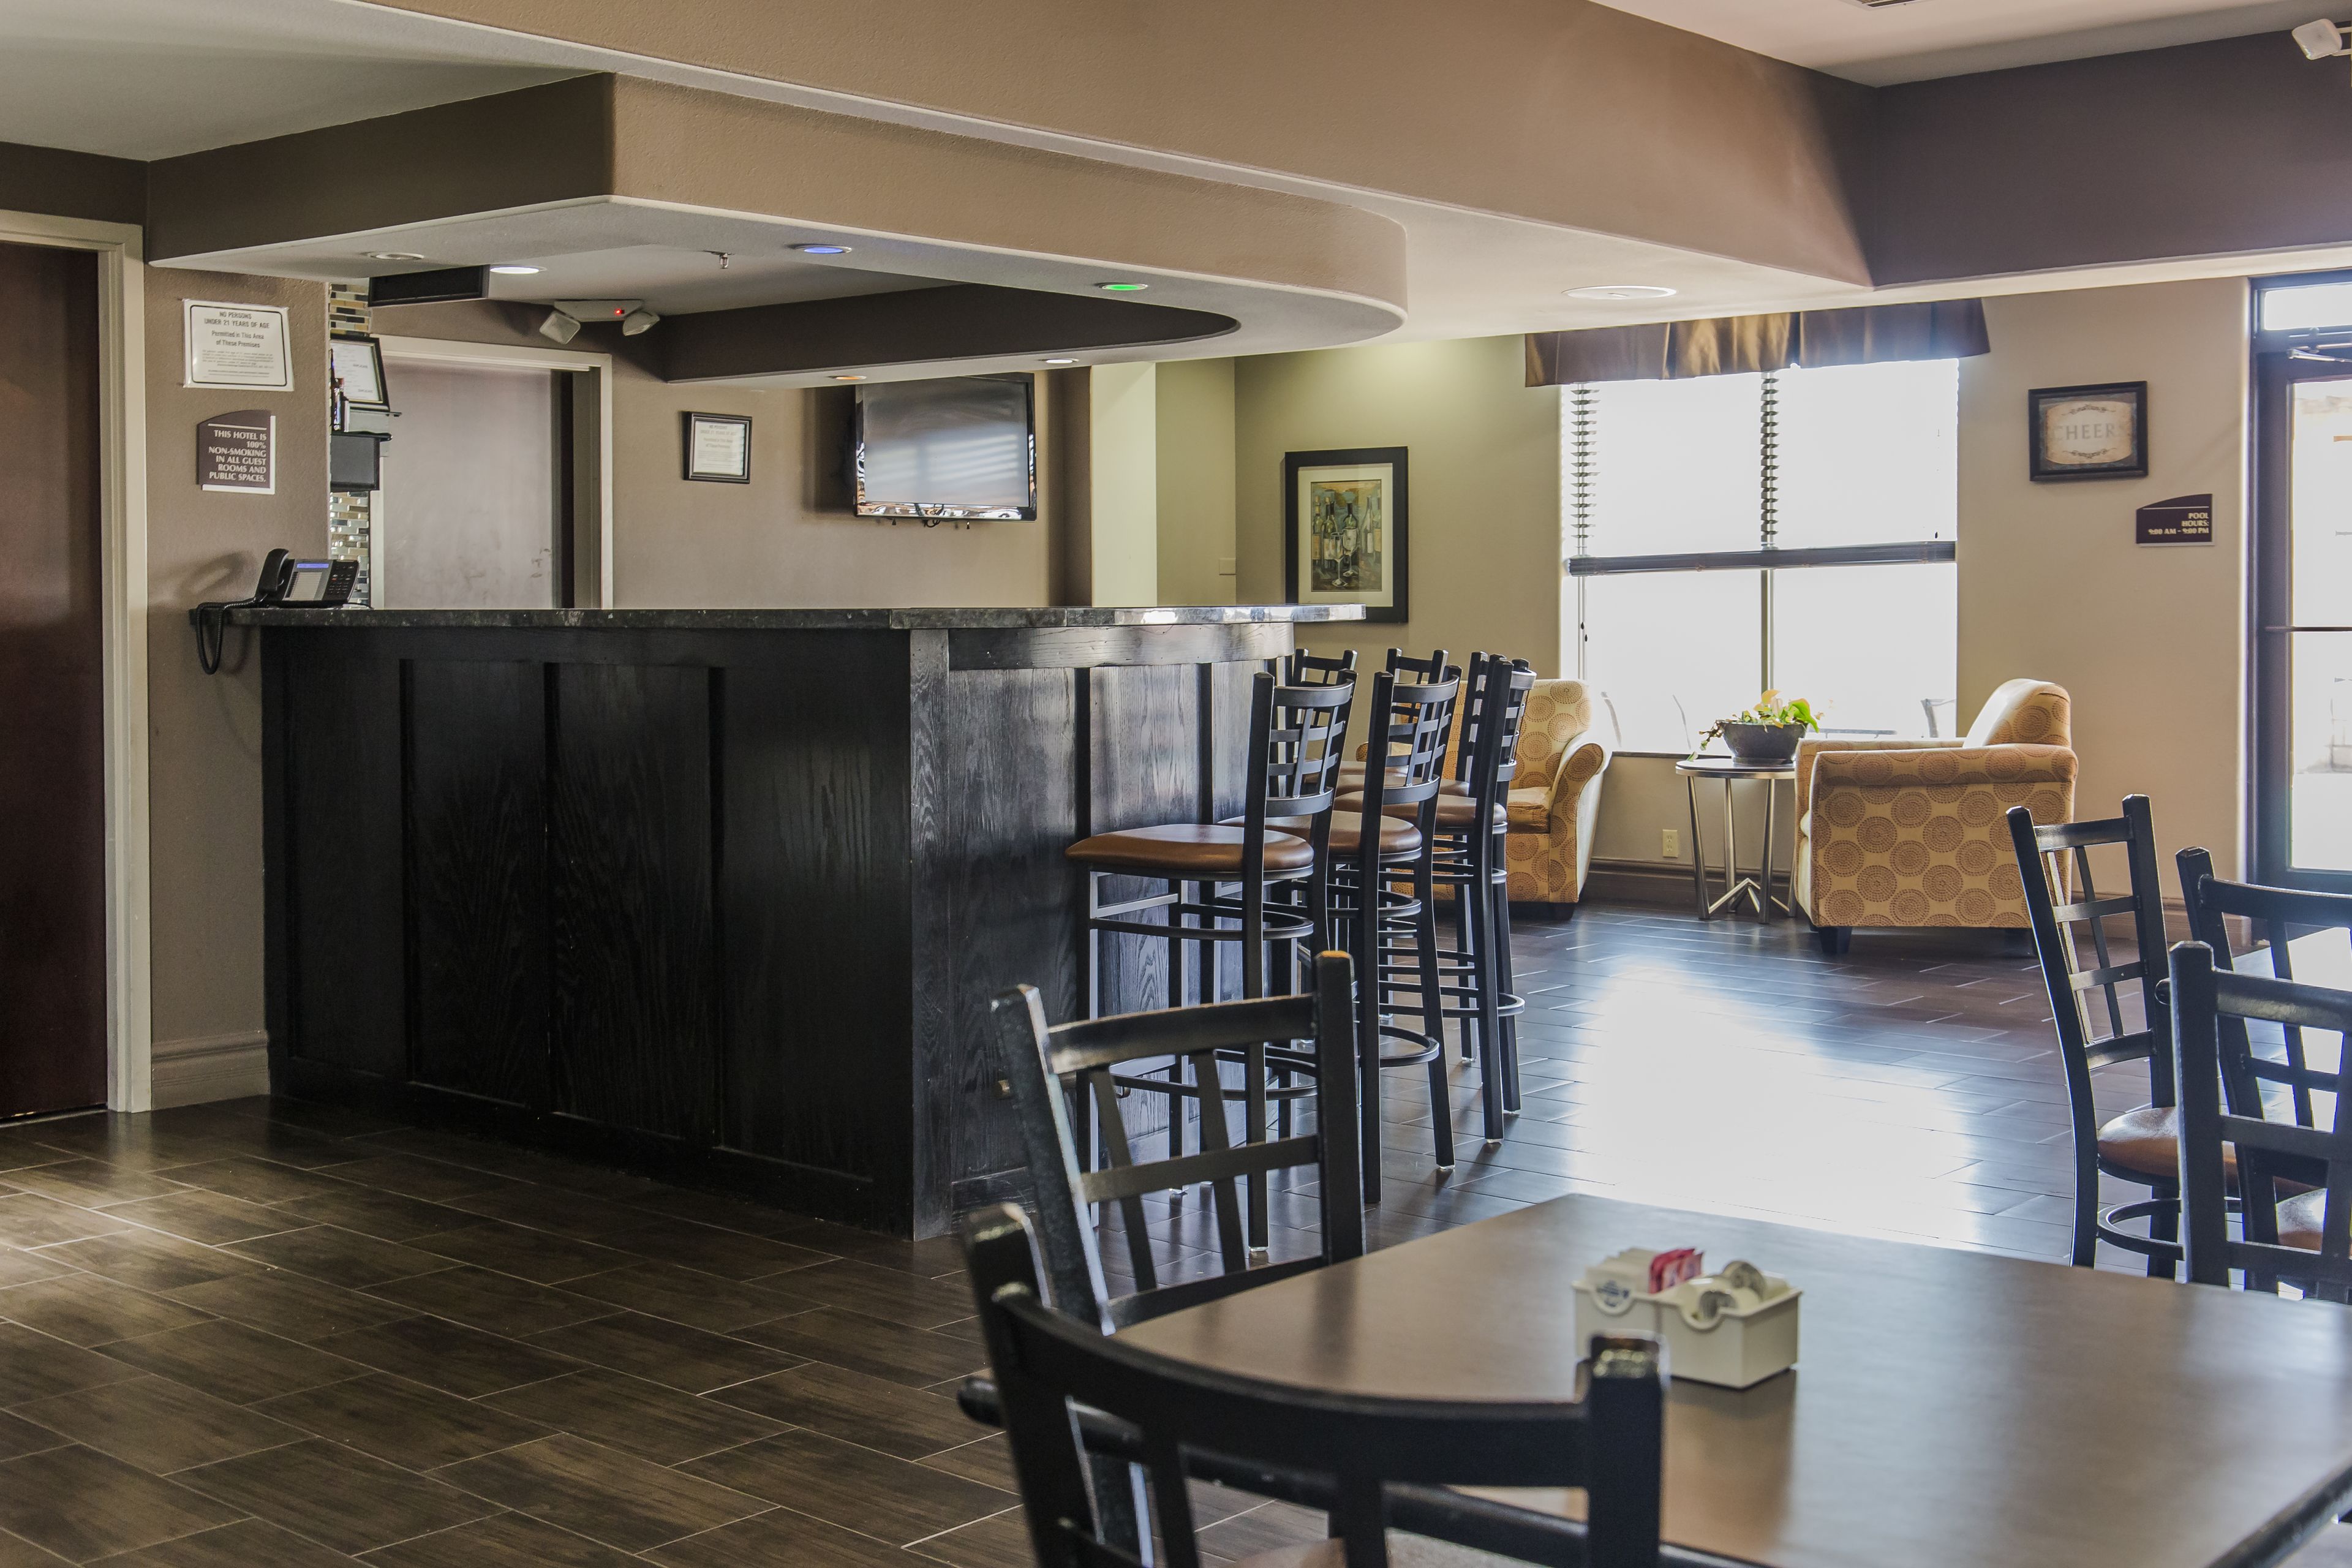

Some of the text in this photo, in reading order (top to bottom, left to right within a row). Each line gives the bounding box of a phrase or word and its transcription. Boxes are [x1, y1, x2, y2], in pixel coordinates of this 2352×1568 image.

[214, 429, 232, 439] THIS
[233, 431, 258, 440] HOTEL
[2054, 423, 2125, 440] CHEER
[246, 440, 266, 449] 100%
[208, 447, 266, 458] NON-SMOKING
[242, 457, 266, 466] GUEST
[218, 464, 247, 473] ROOMS
[209, 472, 237, 480] PUBLIC
